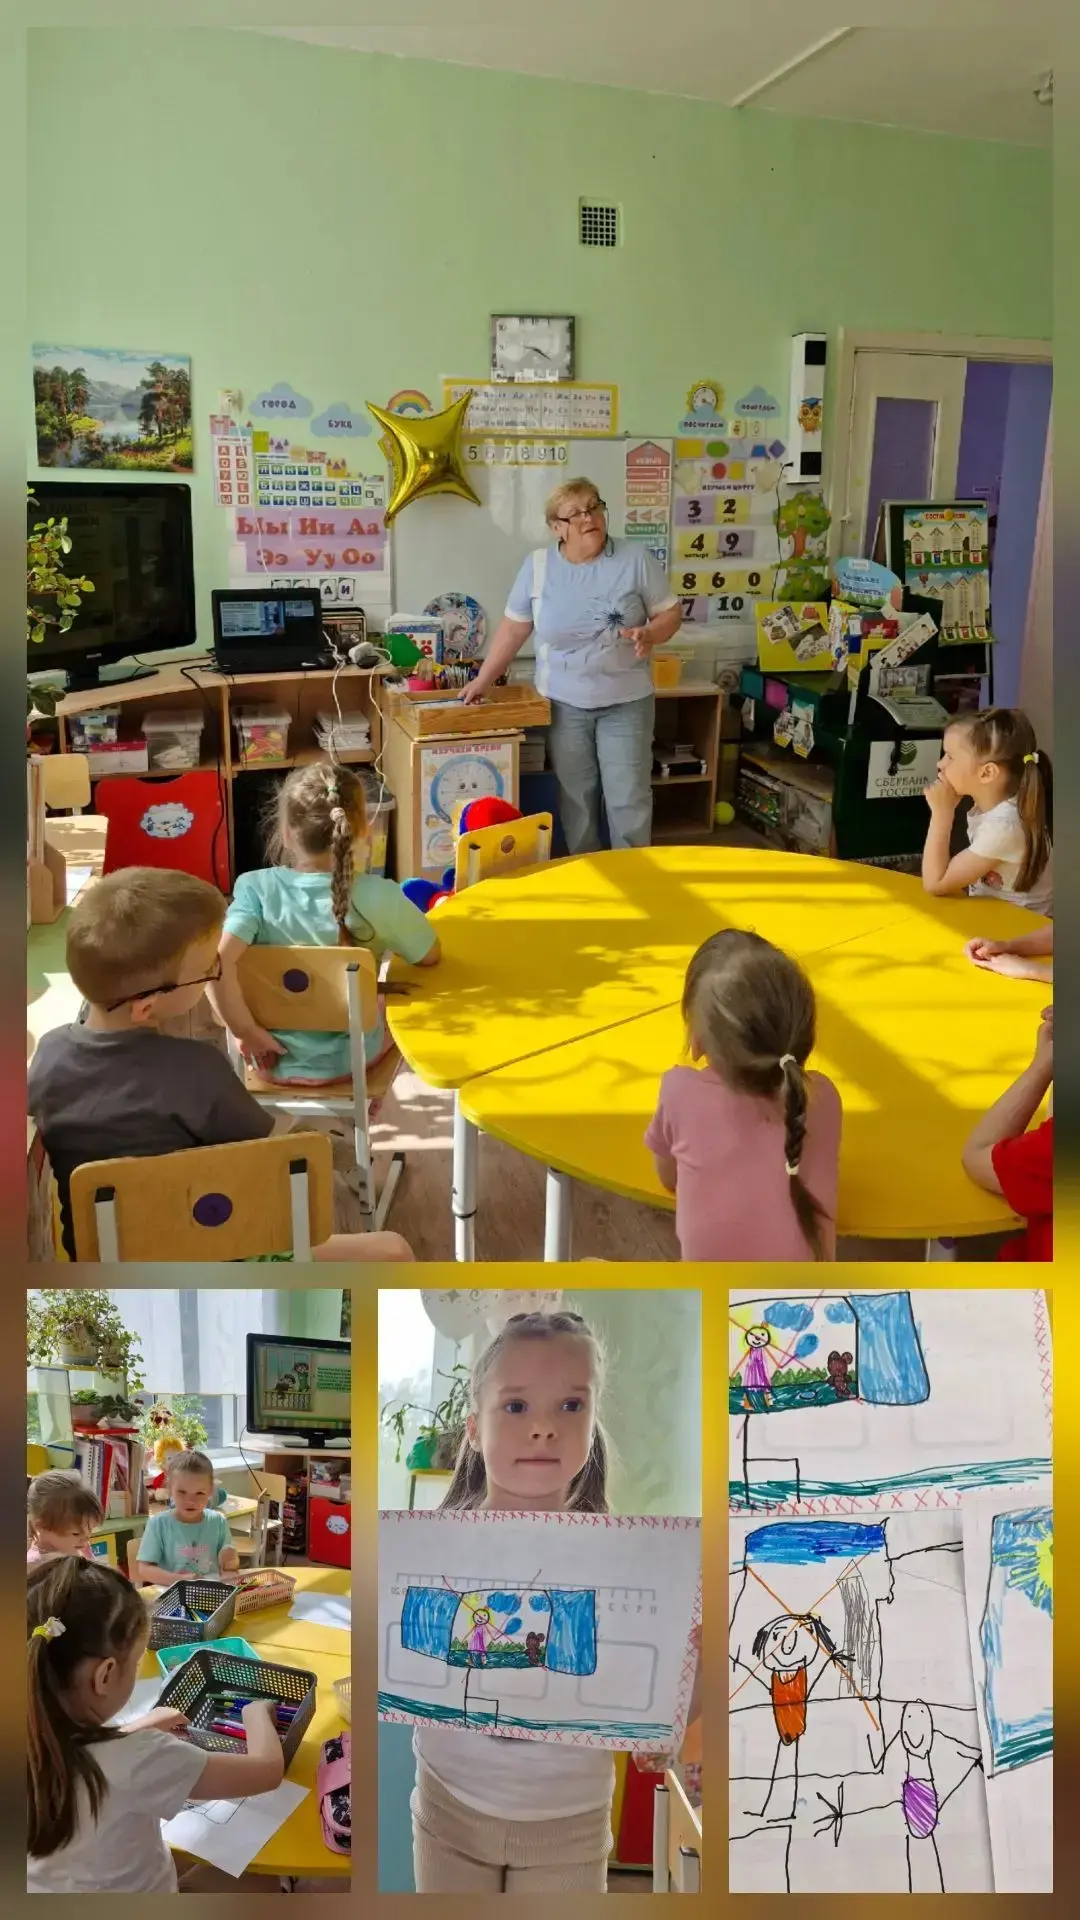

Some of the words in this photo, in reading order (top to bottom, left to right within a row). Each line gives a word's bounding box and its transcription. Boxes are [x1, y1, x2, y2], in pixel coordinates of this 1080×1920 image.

[261, 400, 296, 409] ГОРОД
[468, 445, 478, 460] 5
[521, 446, 530, 460] 8
[549, 446, 567, 461] 10
[688, 500, 702, 518] 3
[722, 498, 736, 514] 2
[236, 517, 288, 535] Ыы
[298, 518, 335, 535] Ии
[346, 518, 380, 535] Аа
[690, 534, 705, 551] 4
[725, 532, 740, 551] 9
[256, 549, 288, 566] Ээ
[304, 549, 335, 569] Уу
[342, 548, 376, 565] Оо
[682, 573, 696, 590] 8
[712, 572, 726, 588] 6
[748, 572, 761, 587] 0
[682, 598, 695, 617] 7
[717, 596, 744, 611] 10
[875, 776, 929, 787] СБЕРБАНК
